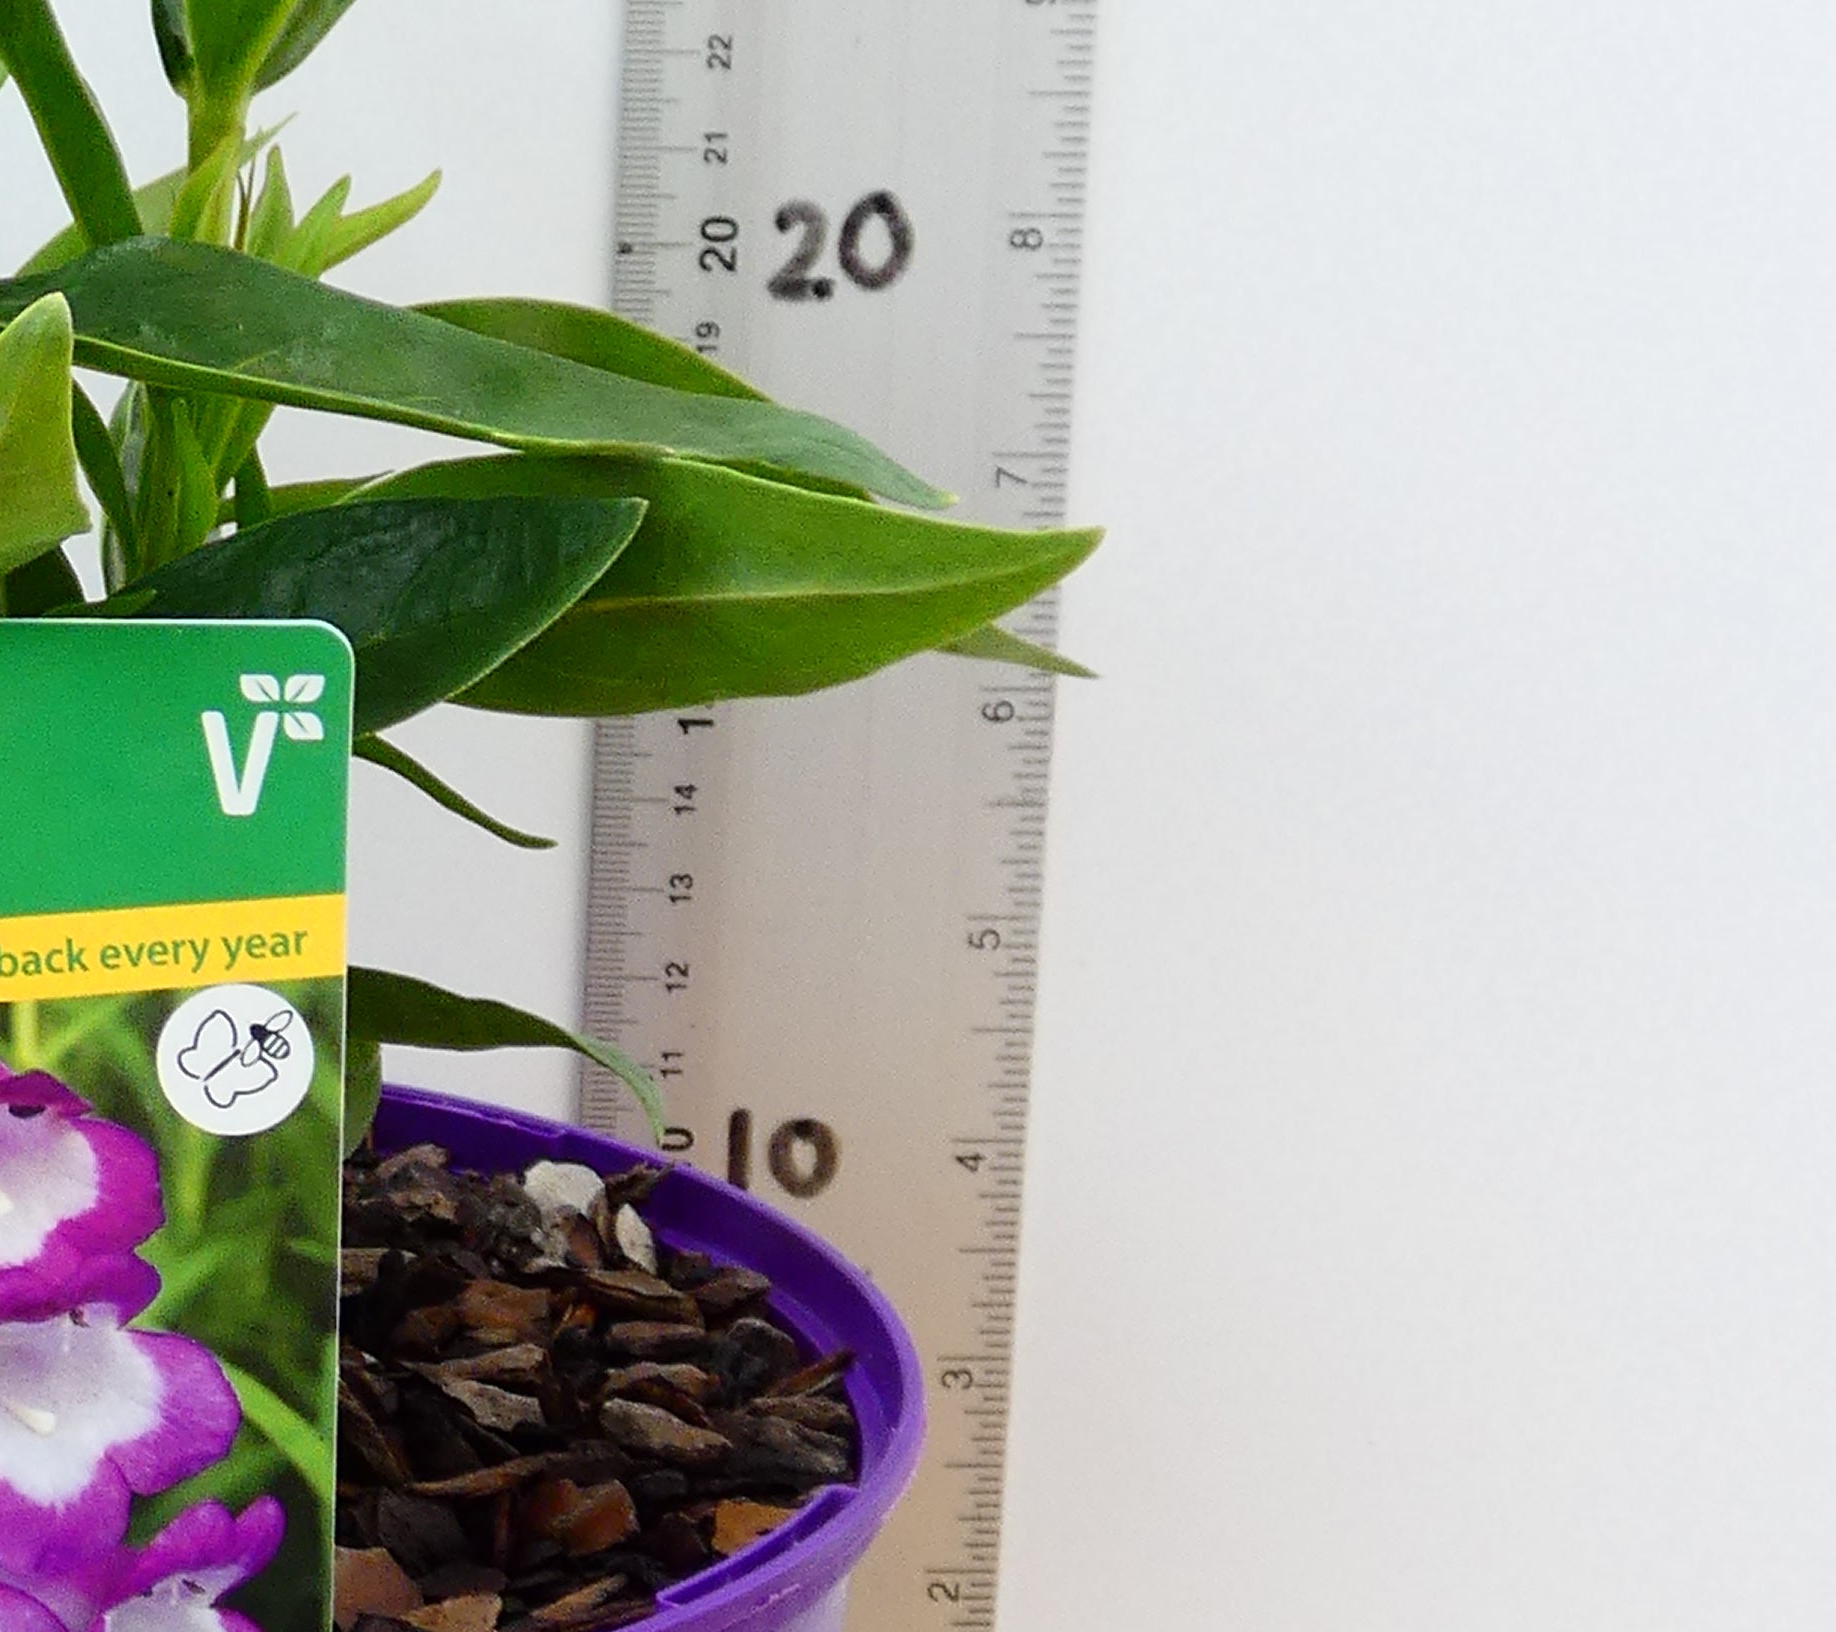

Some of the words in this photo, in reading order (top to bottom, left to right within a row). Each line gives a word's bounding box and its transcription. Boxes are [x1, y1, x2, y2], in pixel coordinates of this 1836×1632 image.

[706, 34, 733, 71] 22
[703, 130, 729, 165] 21
[699, 216, 740, 273] 20
[767, 190, 914, 302] 20
[1009, 227, 1044, 250] 8
[696, 322, 719, 354] 19
[994, 468, 1028, 488] 7
[981, 700, 1015, 724] 6
[673, 784, 699, 815] 14
[669, 873, 694, 904] 13
[99, 935, 210, 974] every
[218, 927, 310, 968] year
[967, 929, 1001, 950] 5
[666, 962, 690, 993] 12
[659, 1050, 686, 1077] 11
[728, 1108, 841, 1198] 10
[954, 1153, 987, 1173] 4
[941, 1369, 974, 1389] 3
[927, 1581, 960, 1603] 2
